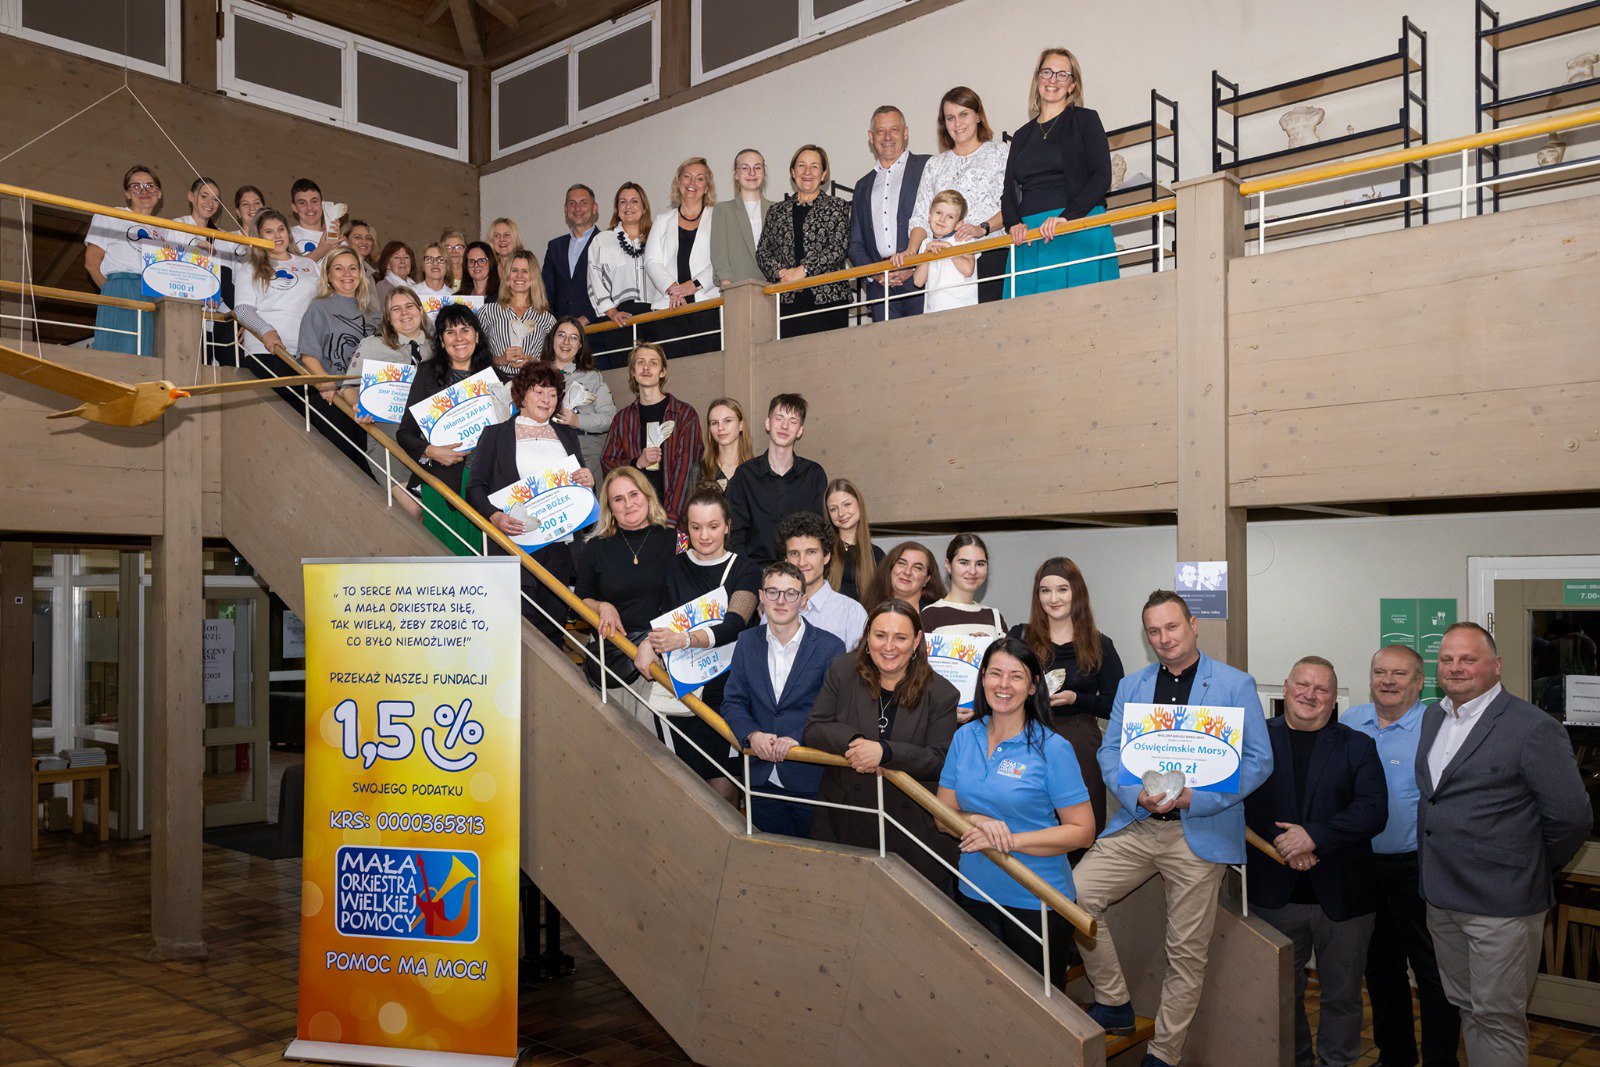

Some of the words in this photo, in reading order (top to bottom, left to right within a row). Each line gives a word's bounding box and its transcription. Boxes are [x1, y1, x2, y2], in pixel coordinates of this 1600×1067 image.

[169, 282, 186, 291] 1000
[388, 404, 404, 414] 200
[442, 416, 466, 432] Jolanta
[457, 424, 481, 440] 2000
[546, 494, 571, 510] BOŻEK
[558, 512, 568, 523] zł
[343, 586, 356, 596] TO
[360, 586, 391, 596] SERCE
[395, 586, 412, 596] MA
[416, 586, 456, 597] WIELKĄ
[460, 586, 488, 597] MOC,
[344, 604, 351, 612] A
[356, 603, 386, 613] MAŁA
[390, 602, 446, 613] ORKIESTRA
[450, 603, 475, 614] SIŁĘ,
[331, 620, 350, 630] TAK
[354, 620, 396, 631] WIELKĄ,
[400, 619, 426, 630] ŻEBY
[430, 618, 467, 630] ZROBIĆ
[472, 620, 489, 632] TO,
[346, 636, 361, 646] CO
[365, 636, 392, 646] BYŁO
[698, 656, 711, 671] 500
[712, 651, 719, 662] zł
[329, 671, 381, 684] PRZEKAŻ
[385, 673, 428, 684] NASZEJ
[433, 674, 488, 685] FUNDACJI
[1134, 742, 1195, 753] Oświęcimskie
[1198, 746, 1227, 757] Morsy
[1158, 761, 1182, 773] 500
[1185, 763, 1197, 774] zł
[352, 782, 407, 795] SWOJEGO
[412, 784, 464, 796] PODATKU
[330, 810, 371, 830] KRS:
[376, 812, 486, 835] 0000365813
[341, 852, 417, 875] MAŁA
[340, 911, 417, 933] POMOCY
[326, 950, 391, 974] POMOC
[398, 956, 428, 976] MA
[435, 959, 488, 980] MOC!
